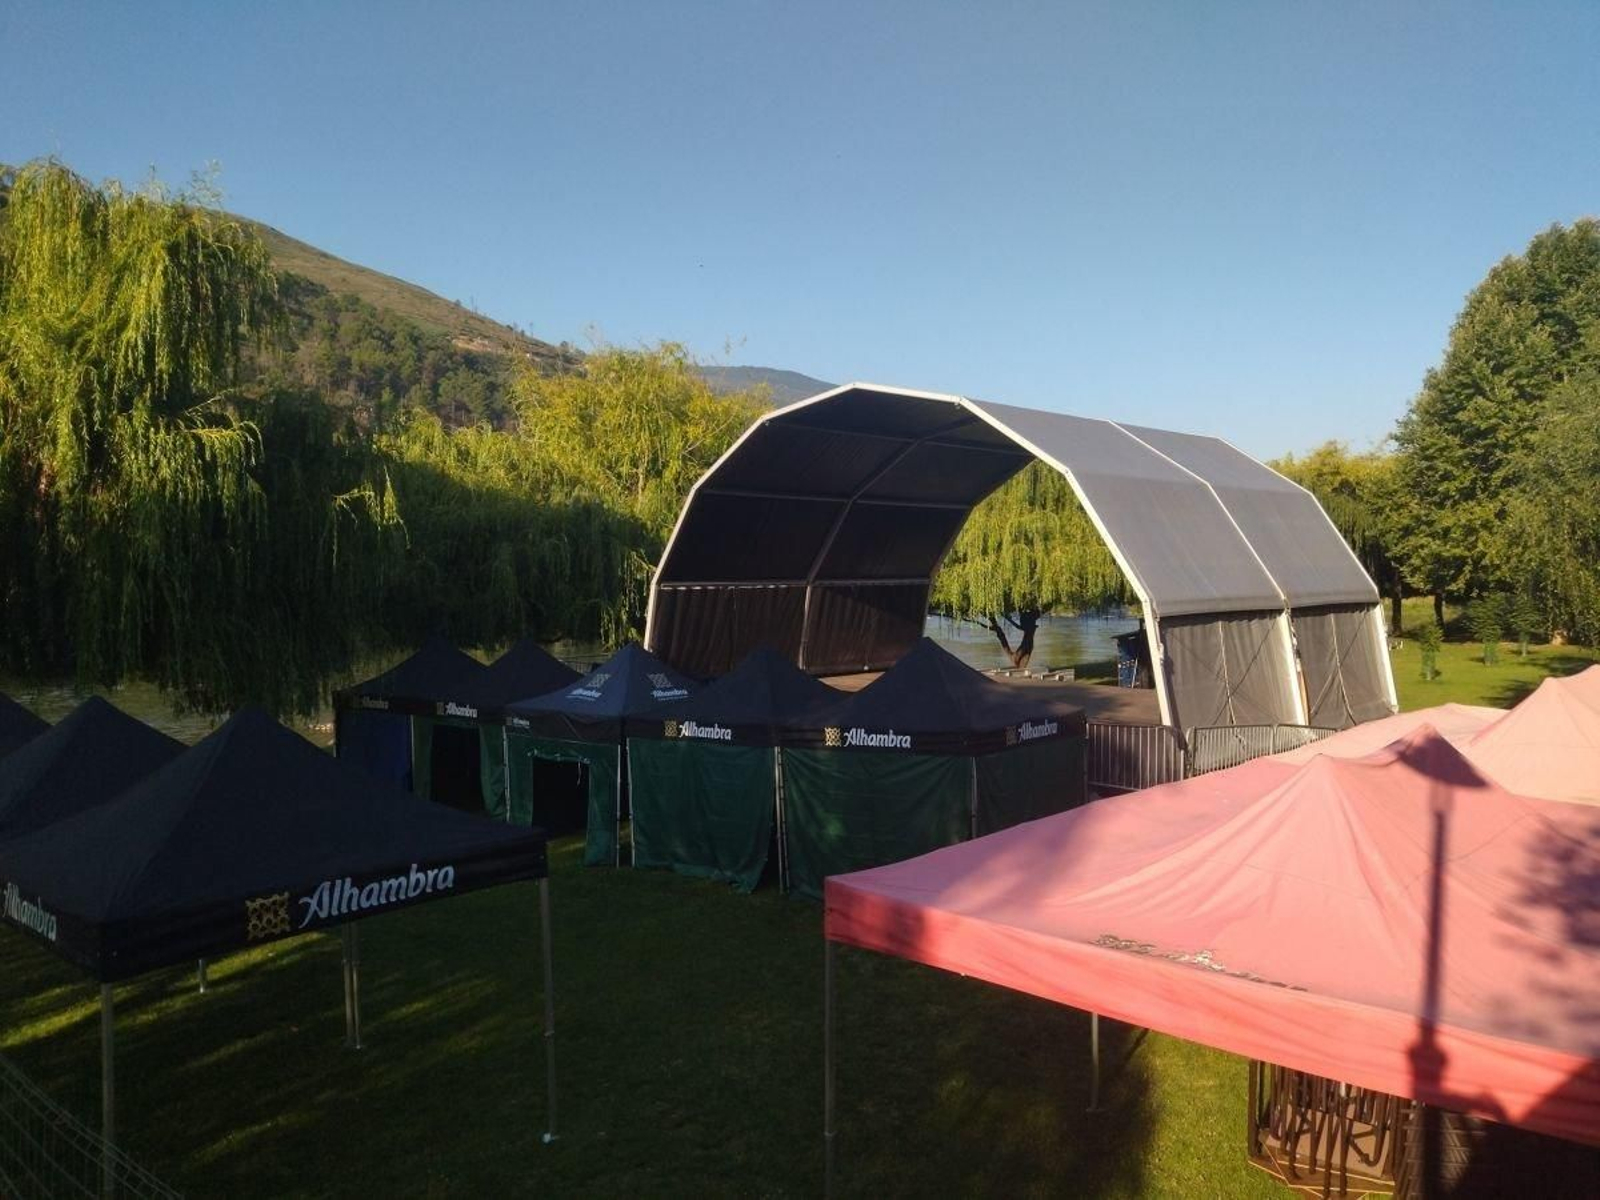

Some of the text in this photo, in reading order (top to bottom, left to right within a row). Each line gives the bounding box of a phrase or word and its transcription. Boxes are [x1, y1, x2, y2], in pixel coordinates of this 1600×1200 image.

[445, 701, 477, 718] Alhambra
[679, 721, 732, 741] Alhambra
[843, 728, 911, 749] Alhambra
[1017, 720, 1058, 740] Alhambra
[298, 863, 455, 927] Alhambra
[2, 881, 57, 942] Alhambra
